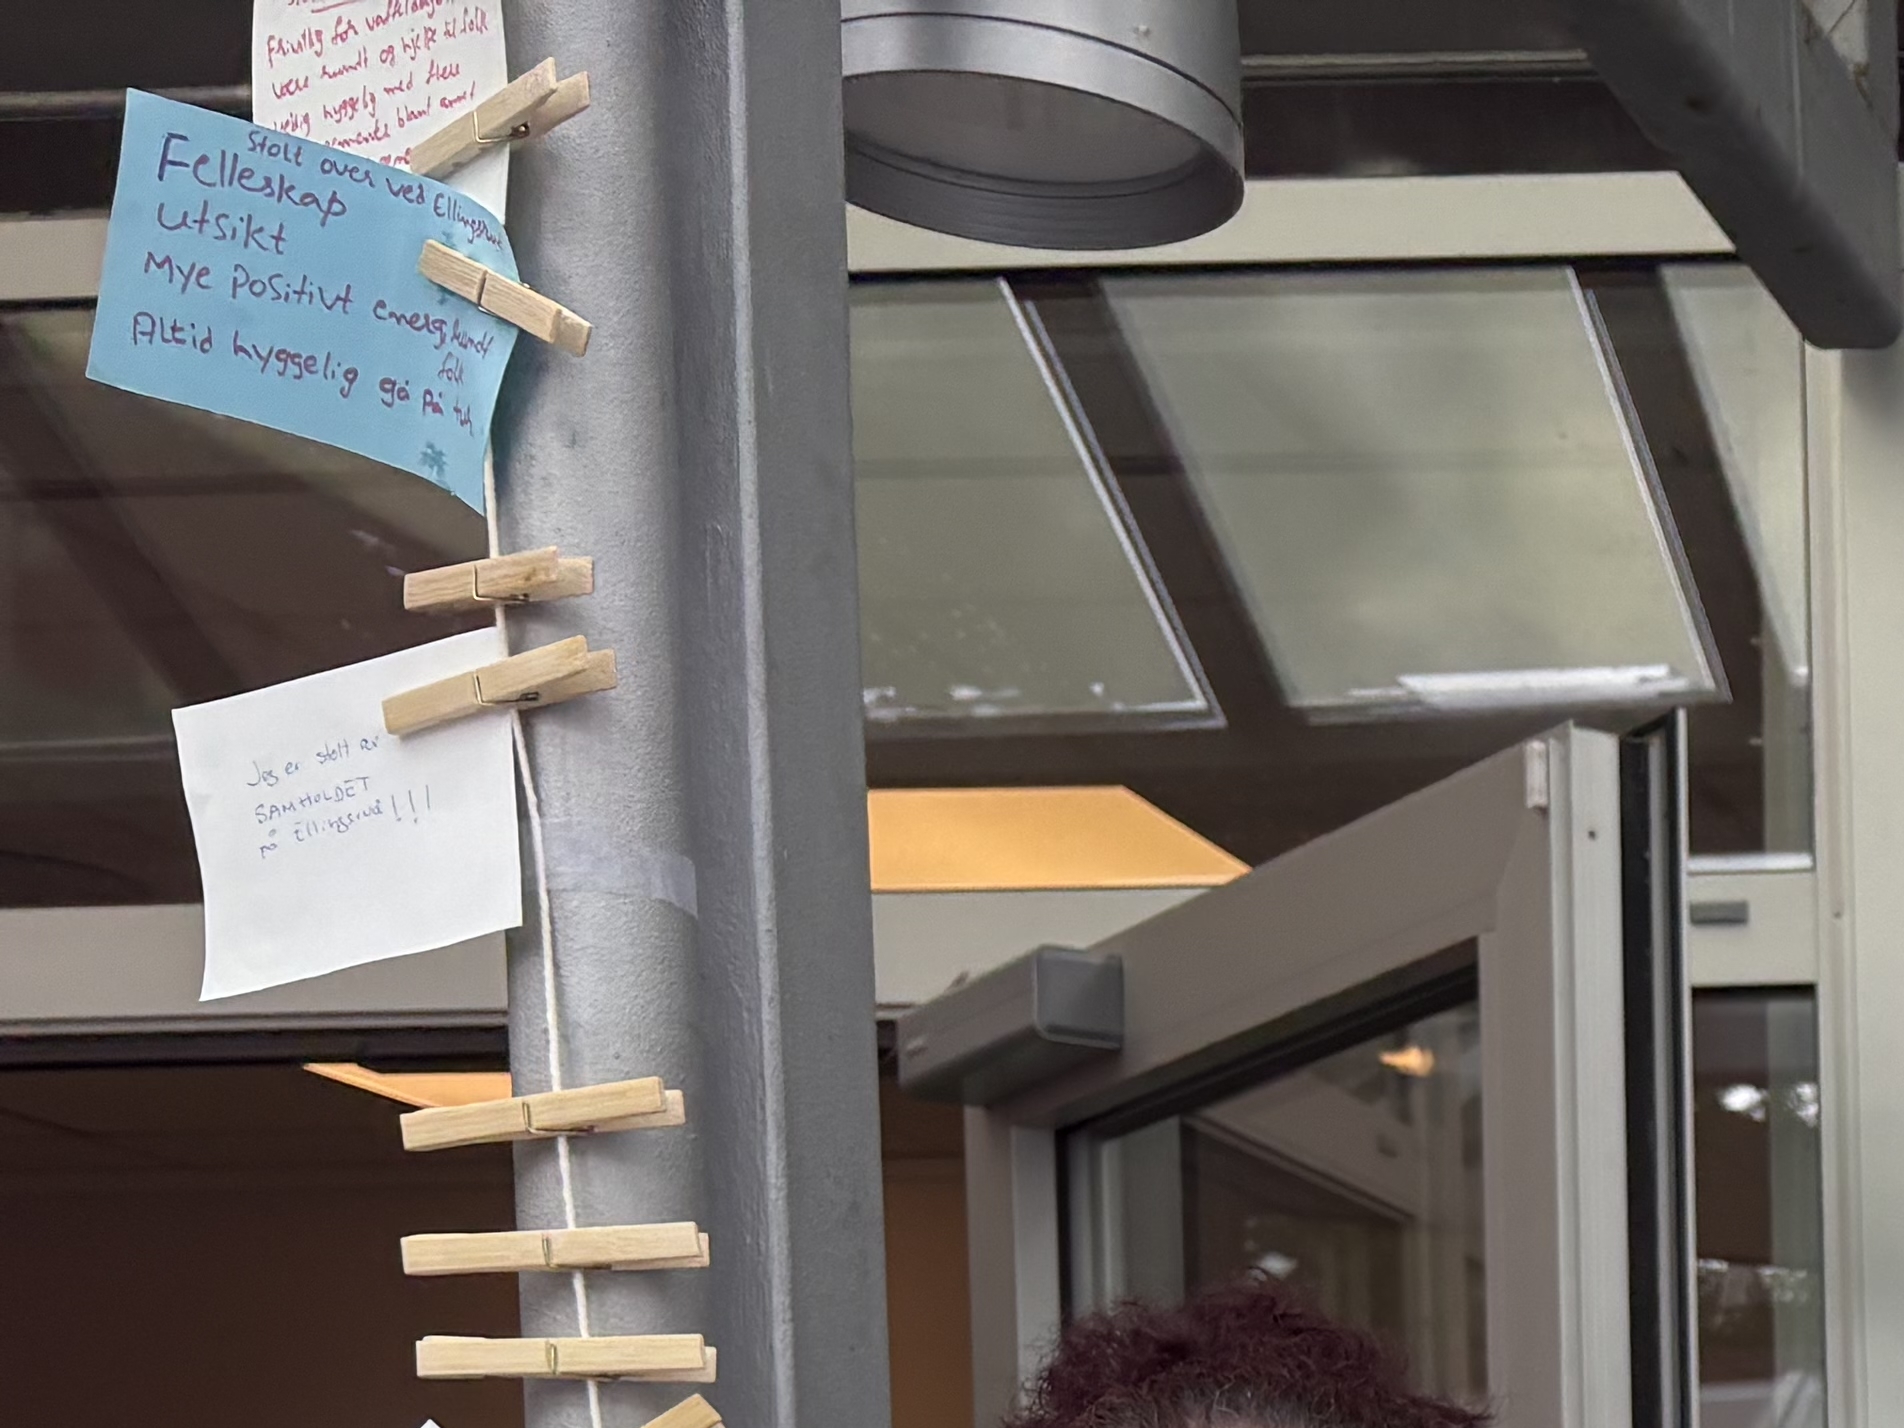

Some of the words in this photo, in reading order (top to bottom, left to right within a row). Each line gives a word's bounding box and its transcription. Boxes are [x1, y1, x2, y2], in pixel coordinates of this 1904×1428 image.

[157, 132, 348, 228] Felleskap
[320, 158, 376, 188] over
[385, 177, 425, 205] ved
[132, 311, 213, 354] Altid
[233, 330, 360, 398] hyggelig
[255, 776, 370, 824] SAMHOLDET
